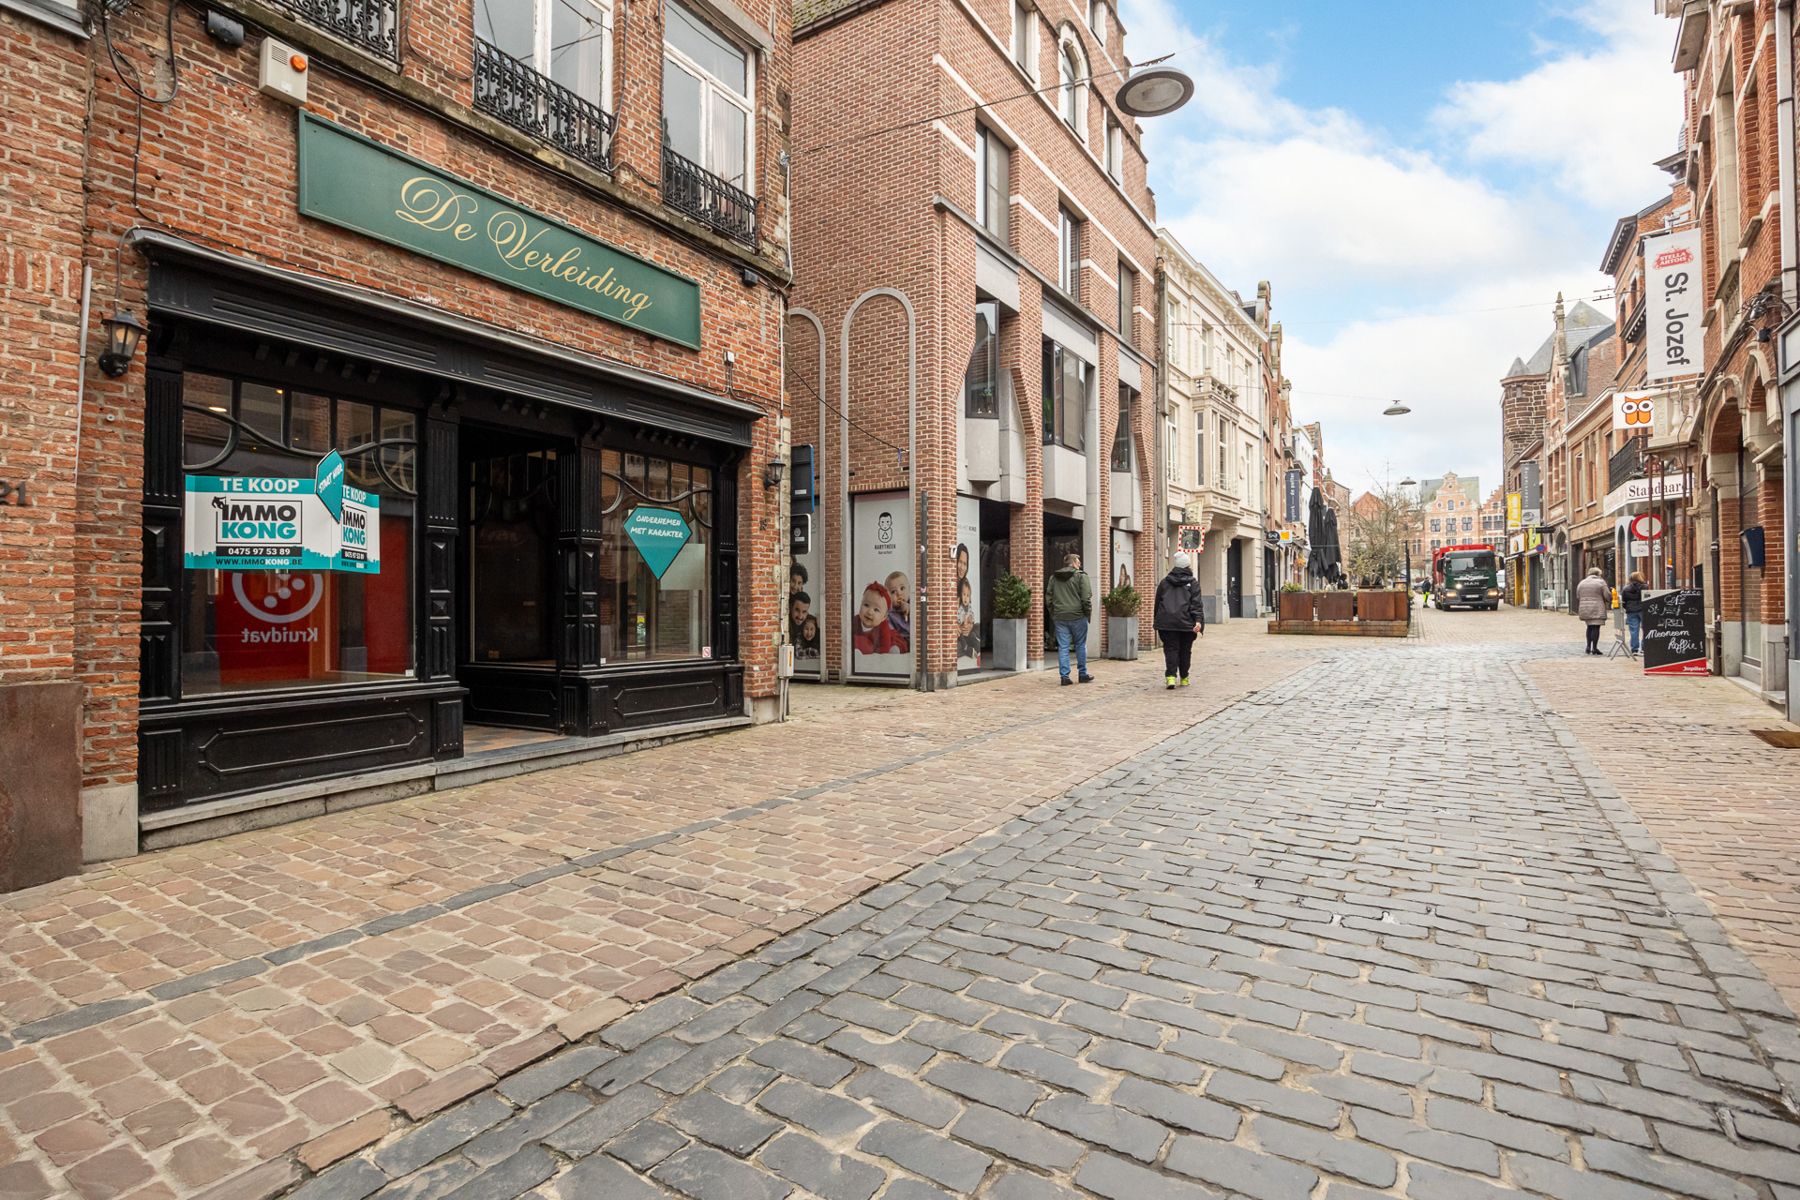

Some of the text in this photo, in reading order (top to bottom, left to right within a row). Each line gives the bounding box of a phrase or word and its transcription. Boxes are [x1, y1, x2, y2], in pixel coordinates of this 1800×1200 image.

[395, 177, 653, 320] De Verleiding
[1665, 272, 1690, 366] St. Jozef
[219, 478, 300, 493] TE KOOP
[343, 485, 366, 503] TE KOOP
[222, 504, 296, 521] IMMO
[343, 510, 366, 529] IMMO
[222, 522, 296, 539] KONG
[343, 527, 366, 545] KONG
[630, 526, 684, 538] MET KARAKTER
